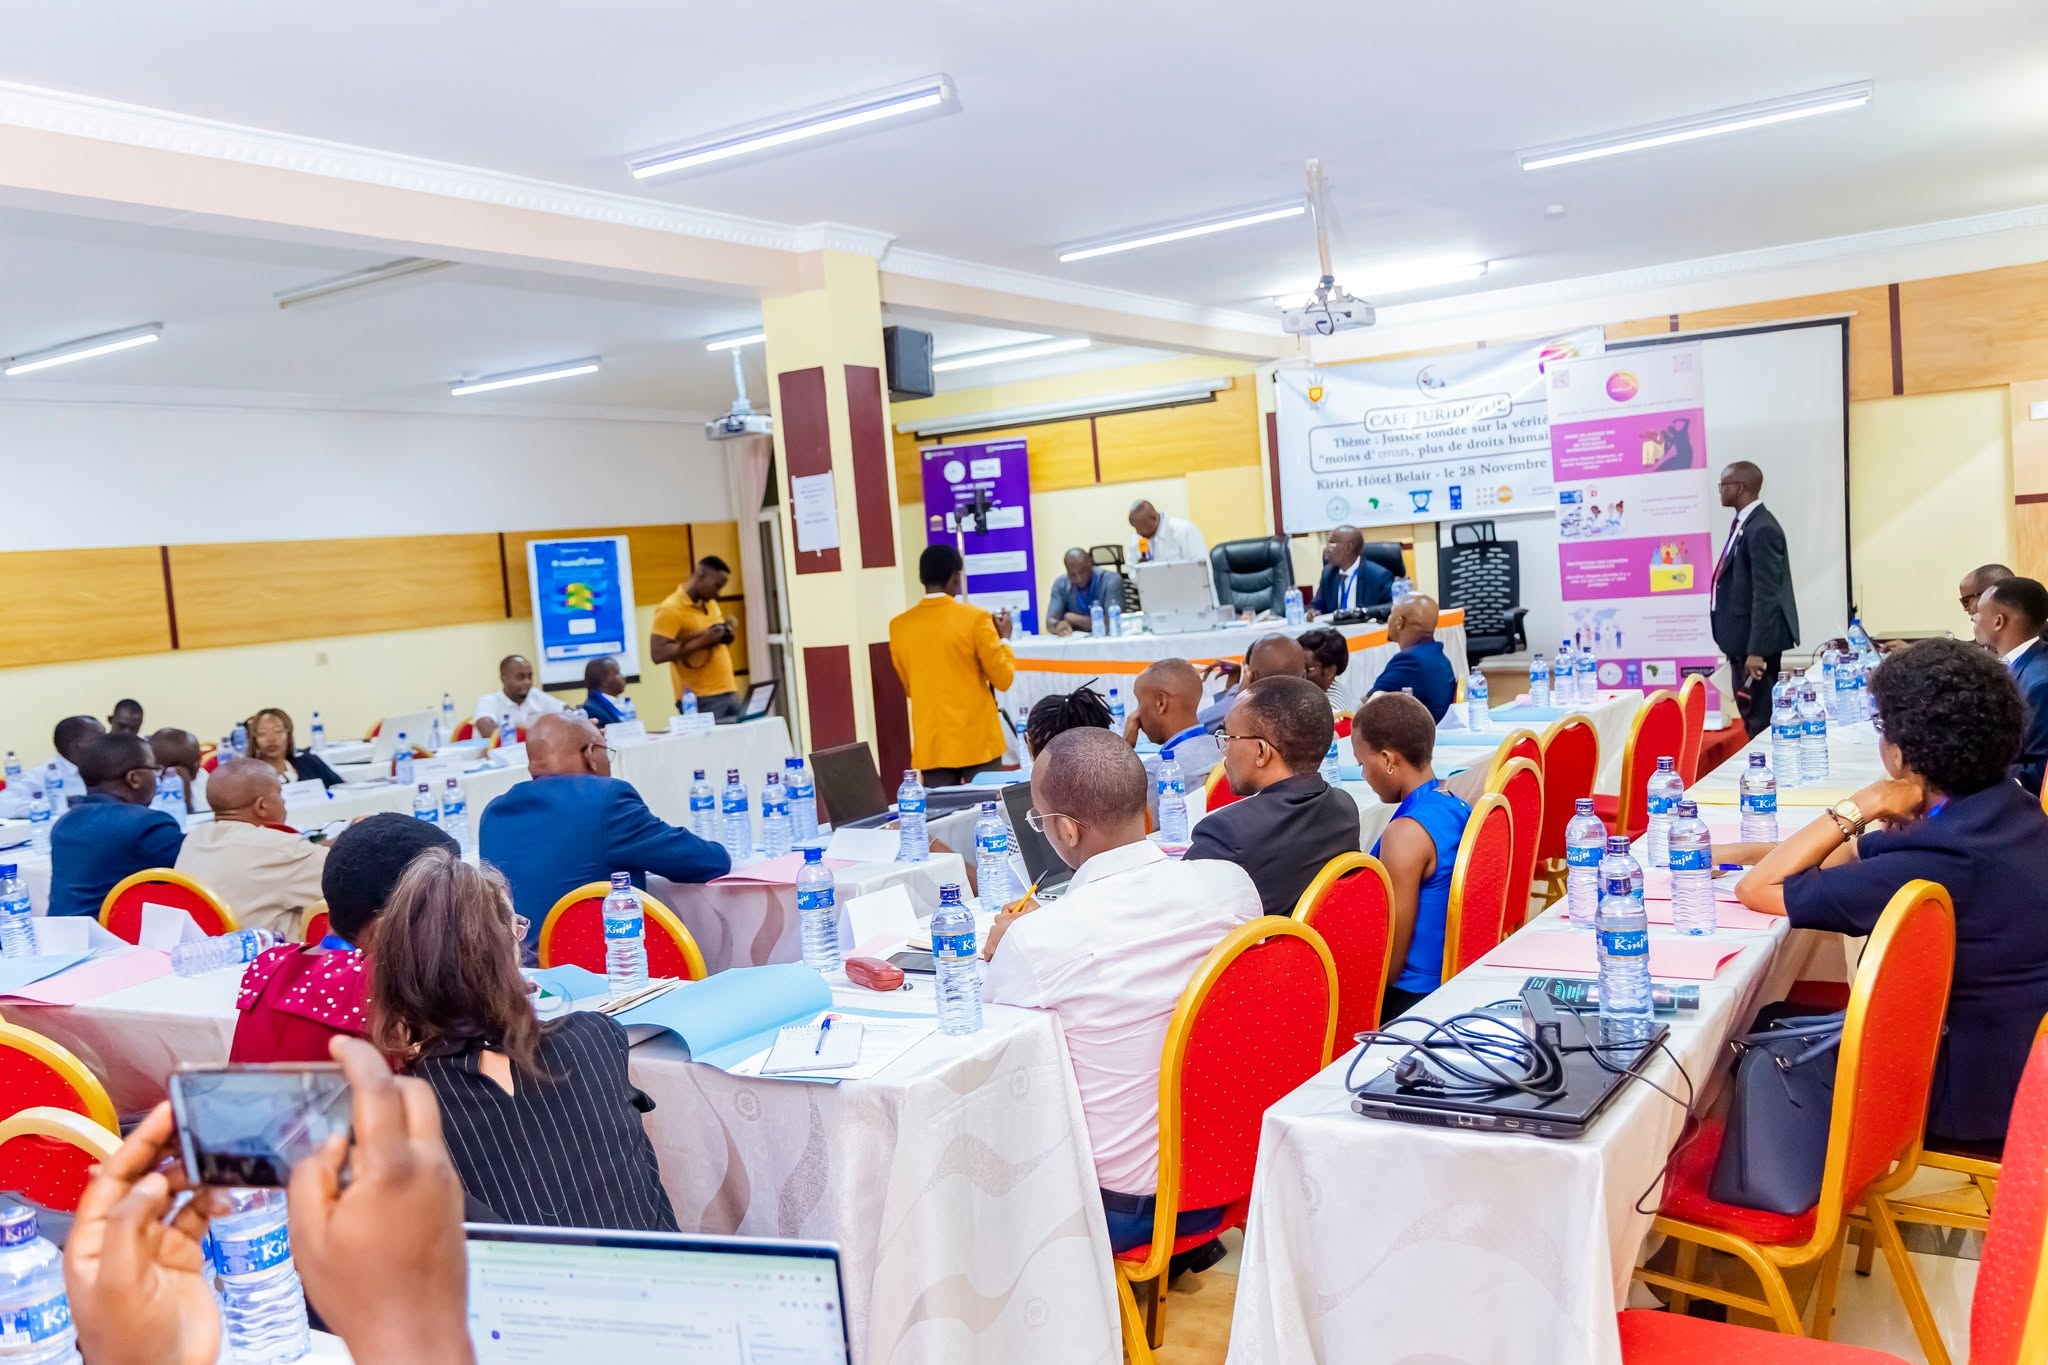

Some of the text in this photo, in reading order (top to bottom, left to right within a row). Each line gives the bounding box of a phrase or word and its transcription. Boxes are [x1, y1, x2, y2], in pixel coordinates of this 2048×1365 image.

[1382, 432, 1422, 445] Justice
[1472, 423, 1491, 433] sur
[1497, 420, 1507, 431] la
[1512, 415, 1549, 428] vérité
[1419, 443, 1444, 458] plus
[1448, 441, 1462, 452] de
[1467, 437, 1504, 450] droits
[1395, 471, 1431, 484] Belair
[1444, 467, 1455, 479] le
[1460, 465, 1476, 478] 28
[1480, 459, 1547, 475] Novembre
